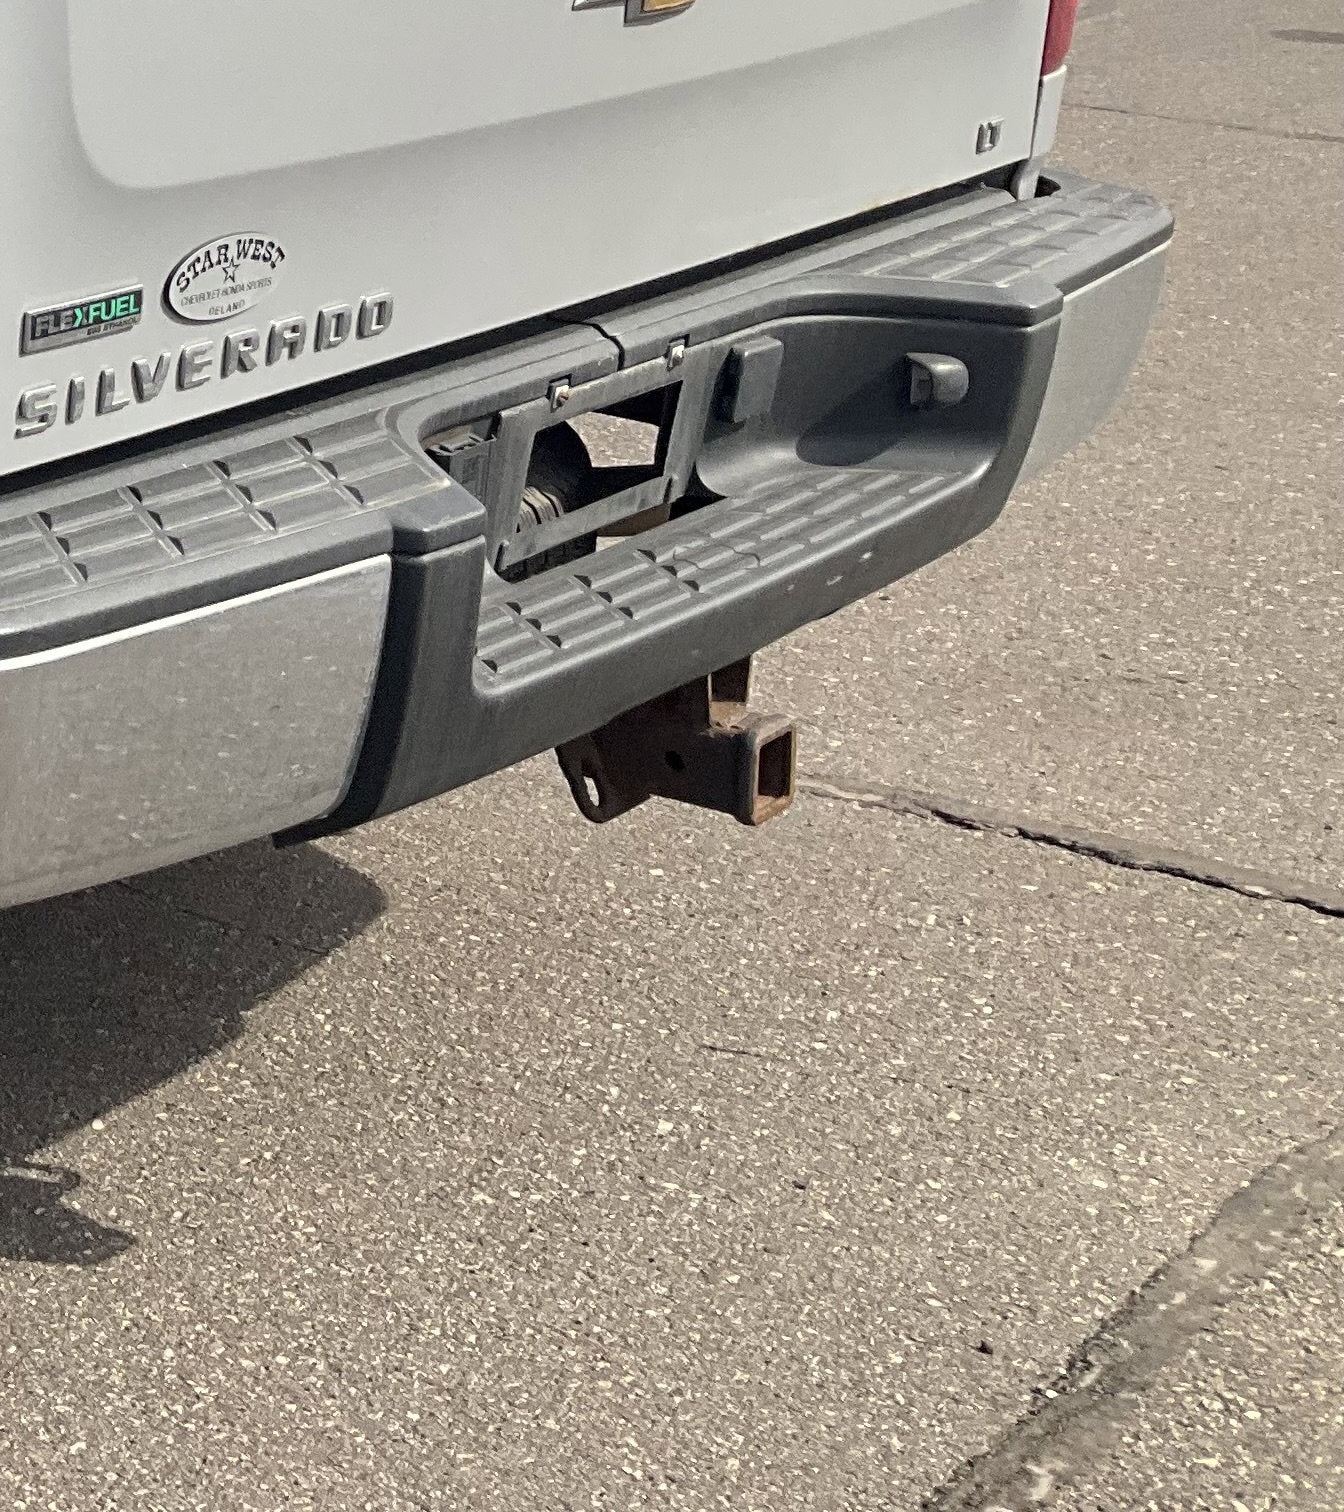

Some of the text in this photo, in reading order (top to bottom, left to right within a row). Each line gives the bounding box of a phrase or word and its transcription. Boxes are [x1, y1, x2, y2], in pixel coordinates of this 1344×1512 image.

[975, 118, 1004, 155] LT
[176, 238, 286, 293] STAR WEST
[208, 299, 246, 316] DELANO
[14, 291, 395, 440] SILVERADO
